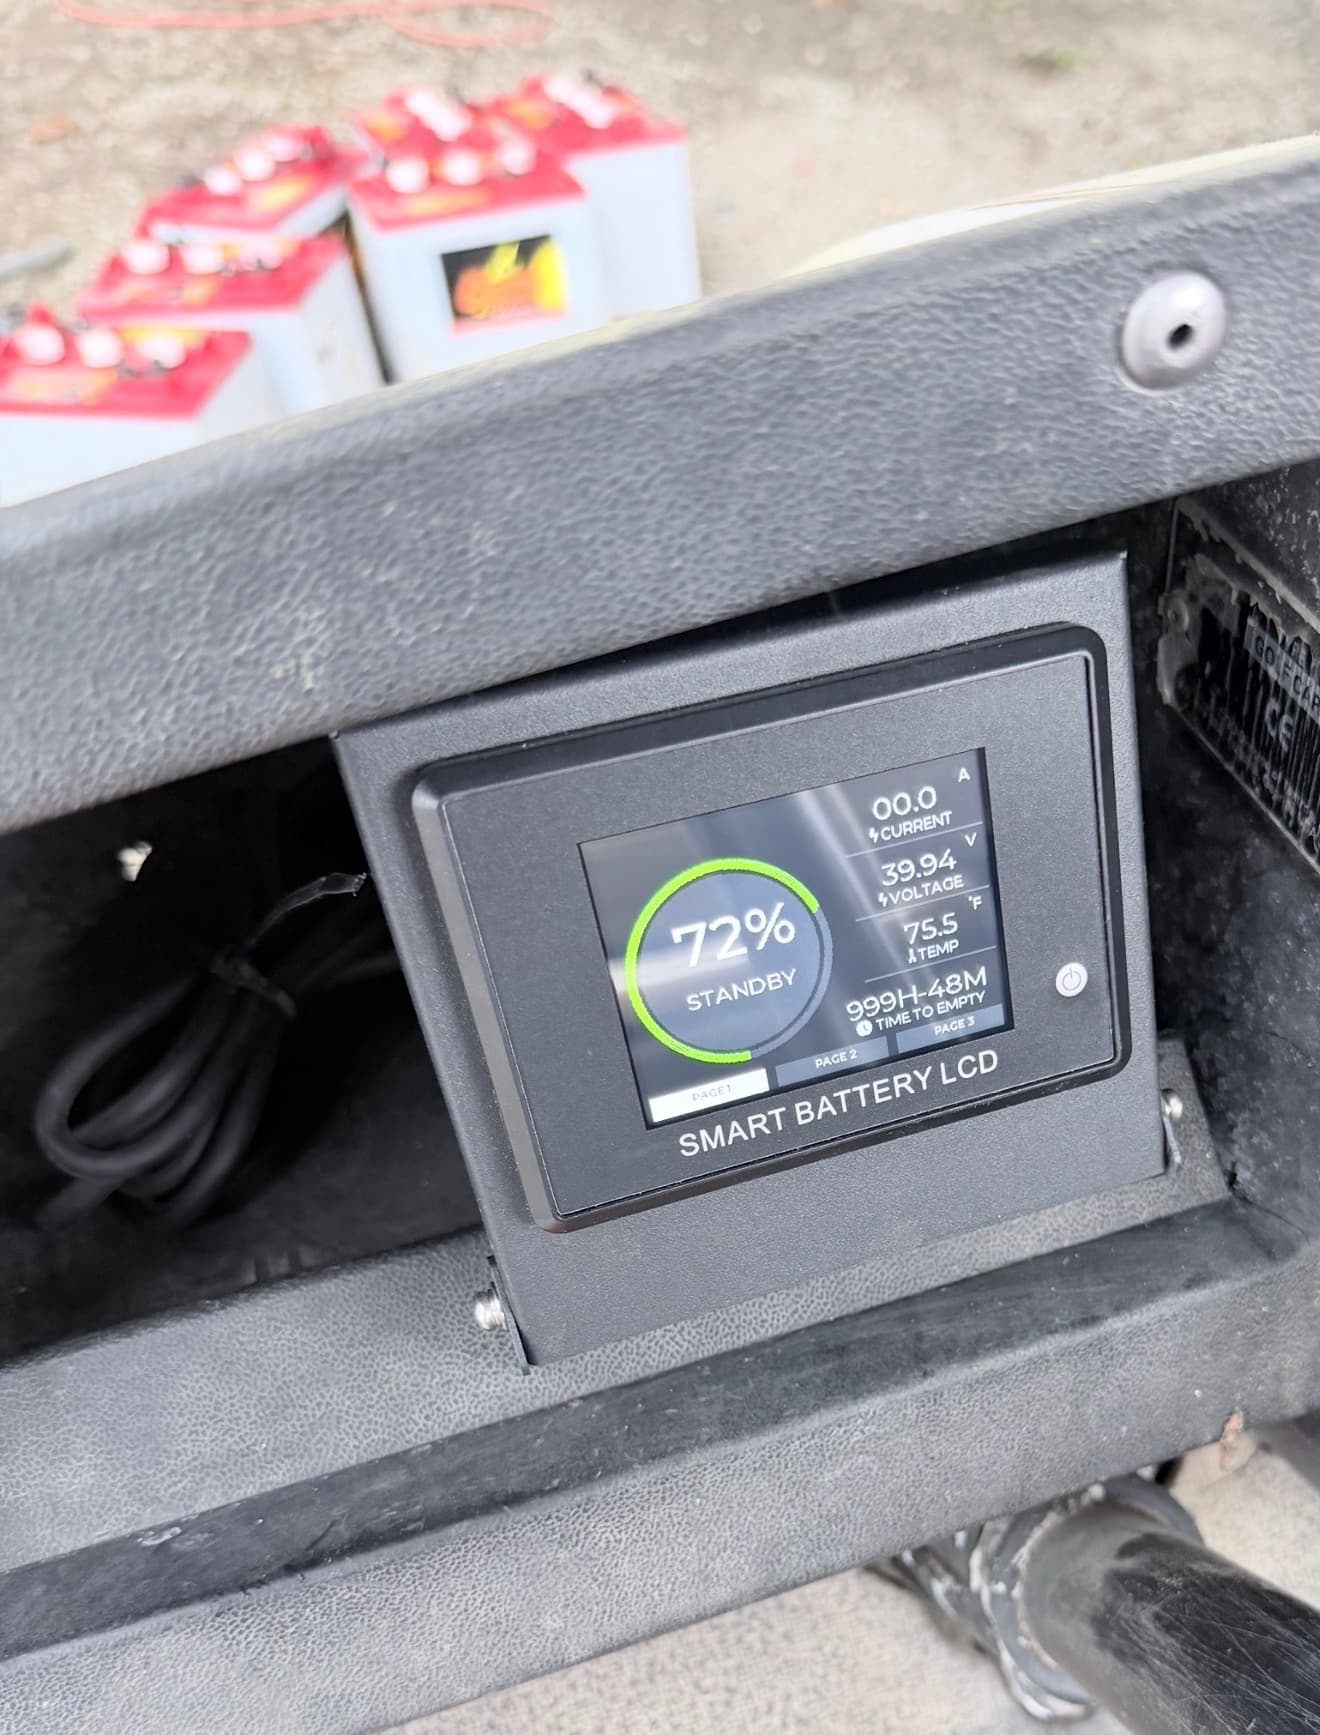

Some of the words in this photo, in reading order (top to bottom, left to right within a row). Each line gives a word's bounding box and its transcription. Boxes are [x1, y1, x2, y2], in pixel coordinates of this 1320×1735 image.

[958, 768, 970, 782] A
[872, 786, 937, 820] 00.0
[880, 811, 953, 841] CURRENT
[964, 832, 977, 847] V
[881, 848, 957, 886] 39.94
[889, 875, 965, 905] VOLTAGE
[671, 902, 795, 967] 72%
[904, 912, 958, 944] 75.5
[918, 939, 959, 961] TEMP
[686, 968, 796, 1011] STANDBY
[846, 966, 987, 1022] 999H-48M
[876, 1011, 912, 1031] TIME
[912, 1006, 934, 1021] TO
[937, 990, 986, 1014] EMPTY
[934, 1020, 966, 1036] PAGE
[967, 1016, 975, 1027] 3
[815, 1053, 848, 1069] PAGE
[849, 1050, 857, 1060] 2
[679, 1107, 786, 1157] SMART
[795, 1066, 932, 1125] BATTERY
[940, 1050, 998, 1085] LCD
[692, 1086, 726, 1101] PAGE
